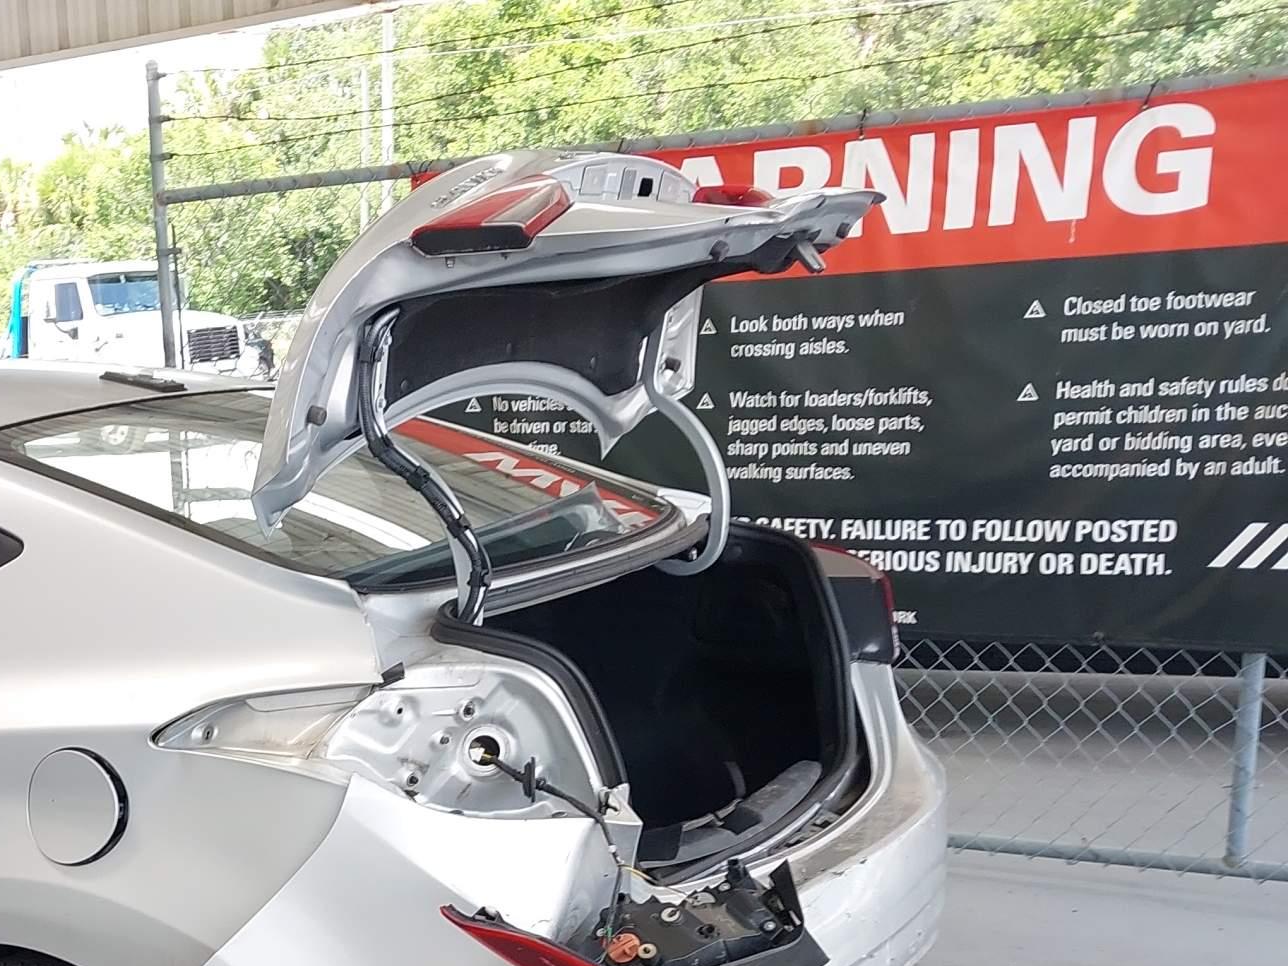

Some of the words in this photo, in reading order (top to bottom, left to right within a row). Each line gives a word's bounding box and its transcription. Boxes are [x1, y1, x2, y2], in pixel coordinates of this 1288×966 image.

[1064, 294, 1125, 316] Closed
[1129, 295, 1161, 312] toe
[1166, 290, 1256, 311] footwear
[730, 316, 768, 333] Look
[772, 313, 808, 331] both
[812, 314, 855, 333] ways
[859, 309, 904, 327] when
[1061, 323, 1107, 342] must
[1111, 321, 1135, 340] be
[1139, 322, 1189, 339] worn
[1194, 321, 1218, 337] on
[1223, 314, 1271, 339] yard.
[730, 340, 795, 359] crossing
[799, 338, 850, 356] aisles.
[729, 391, 776, 408] Watch
[779, 391, 799, 407] for
[804, 386, 933, 408] loaders/forklifts,
[1056, 380, 1115, 400] Health
[1119, 378, 1155, 397] and
[1158, 375, 1216, 398] safety
[1219, 374, 1269, 394] rules
[492, 396, 509, 411] No
[1053, 405, 1113, 429] permit
[1116, 405, 1187, 424] children
[1191, 404, 1210, 421] in
[1214, 402, 1250, 420] the
[493, 417, 509, 433] be
[509, 417, 550, 434] driven
[553, 420, 568, 433] or
[727, 415, 776, 435] jagged
[780, 417, 828, 435] edges,
[831, 414, 874, 431] loose
[878, 414, 925, 434] parts,
[727, 440, 768, 459] sharp
[772, 440, 817, 459] points
[821, 439, 849, 456] and
[853, 441, 911, 456] uneven
[1051, 433, 1094, 456] yard
[1098, 434, 1120, 451] or
[1124, 431, 1192, 453] bidding
[1198, 433, 1247, 450] area,
[727, 463, 782, 483] walking
[785, 462, 855, 480] surfaces.
[1049, 458, 1171, 481] accompanied
[1175, 457, 1199, 479] by
[1204, 459, 1227, 475] an
[1230, 455, 1286, 475] adult.
[841, 519, 931, 541] FAILURE
[936, 519, 967, 541] TO
[971, 519, 1072, 542] FOLLOW
[1075, 519, 1178, 543] POSTED
[945, 551, 1035, 574] INJURY
[1039, 552, 1074, 575] OR
[1080, 552, 1173, 576] DEATH.
